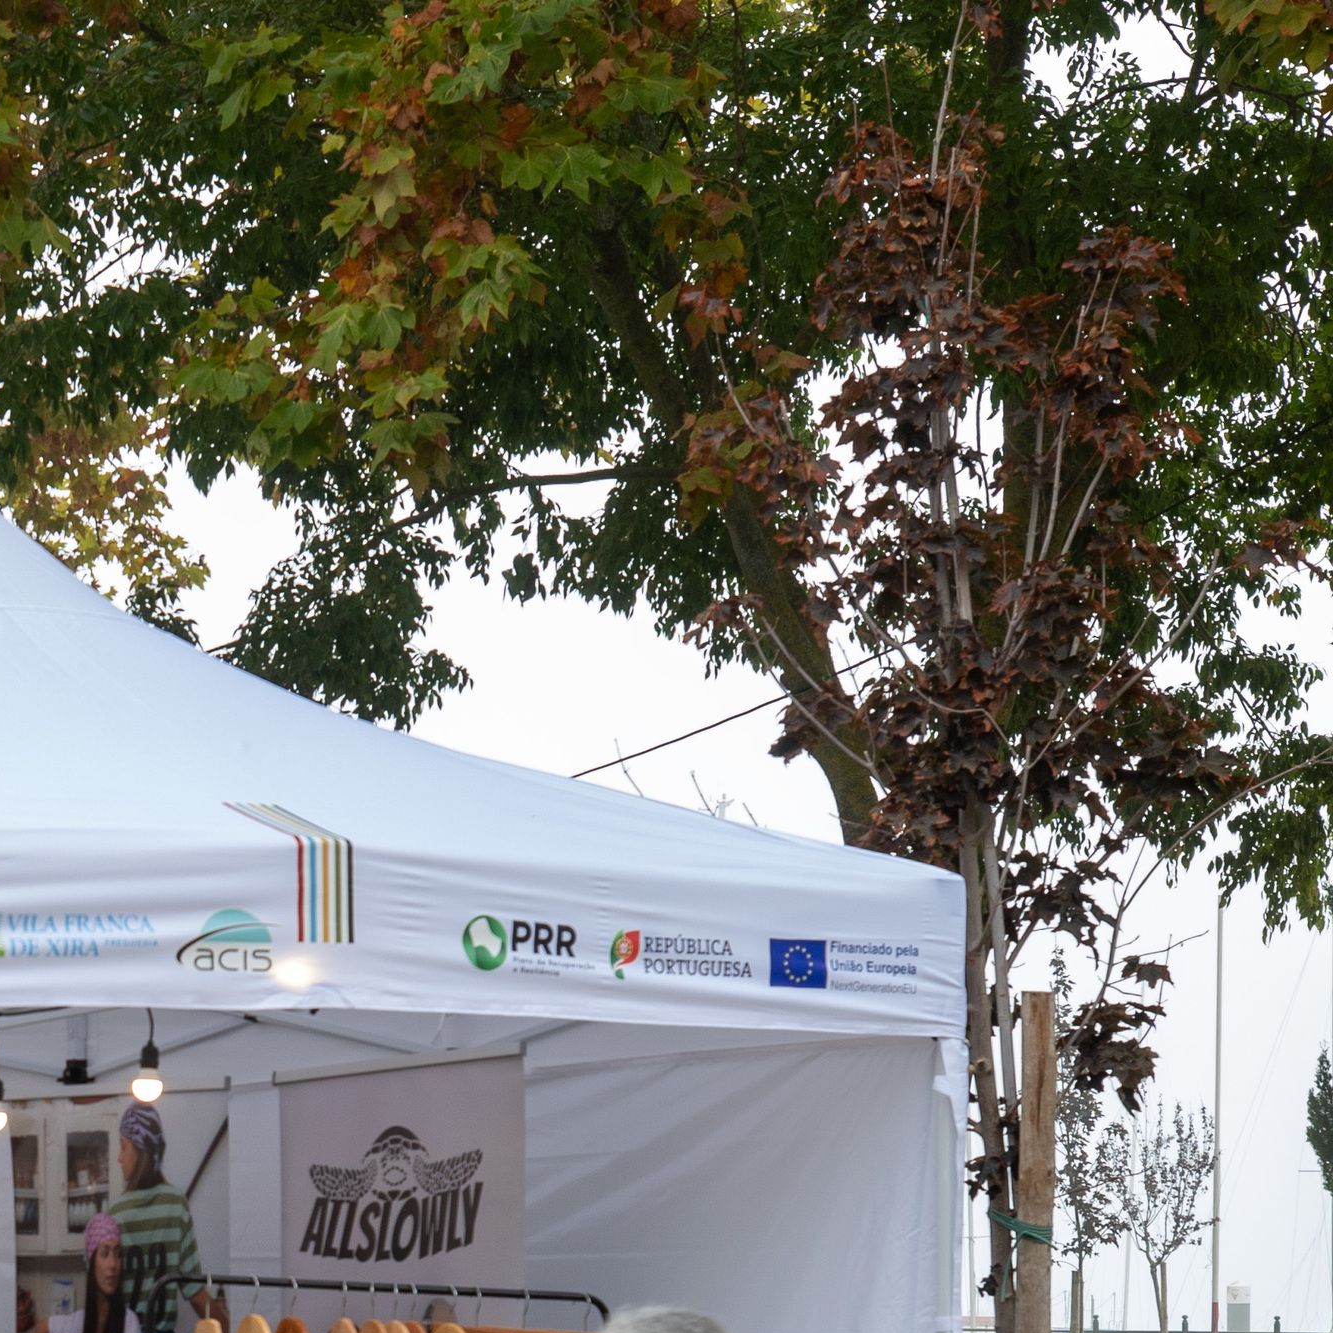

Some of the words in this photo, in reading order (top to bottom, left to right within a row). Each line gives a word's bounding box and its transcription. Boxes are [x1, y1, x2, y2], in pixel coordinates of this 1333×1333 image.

[7, 913, 58, 934] VILA
[64, 913, 156, 934] FRANCA
[9, 937, 40, 959] DE
[47, 936, 101, 959] XIRA
[511, 920, 578, 958] PRR
[644, 934, 734, 957] REPÚBLICA
[830, 940, 893, 956] Financiado
[895, 944, 920, 959] pela
[193, 947, 273, 973] acis
[644, 958, 753, 979] PORTUGUESA
[830, 959, 864, 973] União
[866, 960, 917, 977] Europeia
[830, 980, 918, 995] NextGenerationEU
[299, 1181, 484, 1263] ALLSLOWLY
